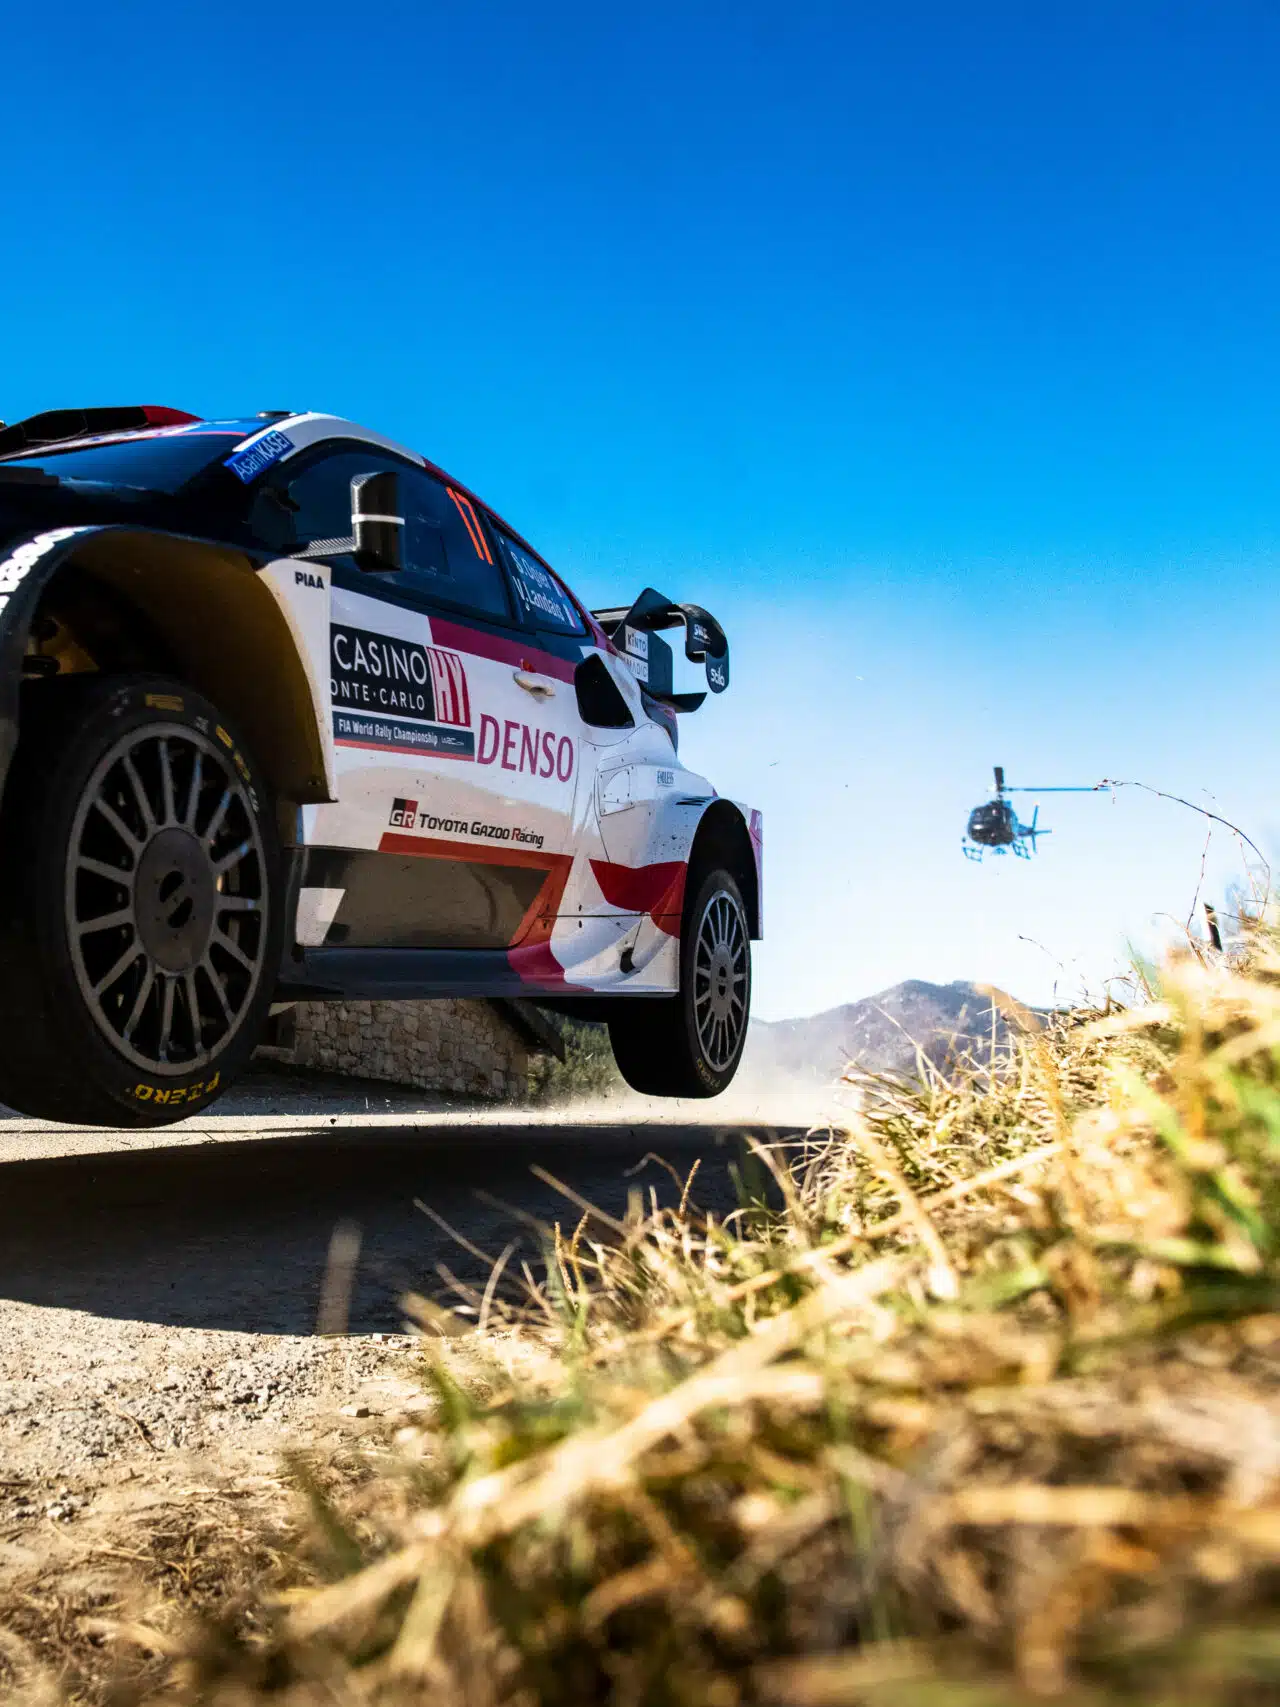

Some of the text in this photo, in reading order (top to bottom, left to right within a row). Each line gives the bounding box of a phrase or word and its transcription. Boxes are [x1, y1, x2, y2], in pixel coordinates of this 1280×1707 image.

[446, 486, 494, 565] 17
[295, 571, 325, 589] PIAA
[333, 634, 427, 685] CASINO
[331, 678, 425, 711] ONTE·CARLO
[338, 718, 352, 733] FIA
[352, 721, 373, 737] World
[374, 724, 392, 741] Rally
[394, 727, 438, 746] Championship
[477, 713, 574, 782] DENSO
[391, 810, 544, 849] GR TOYOTA GAZOO Racing
